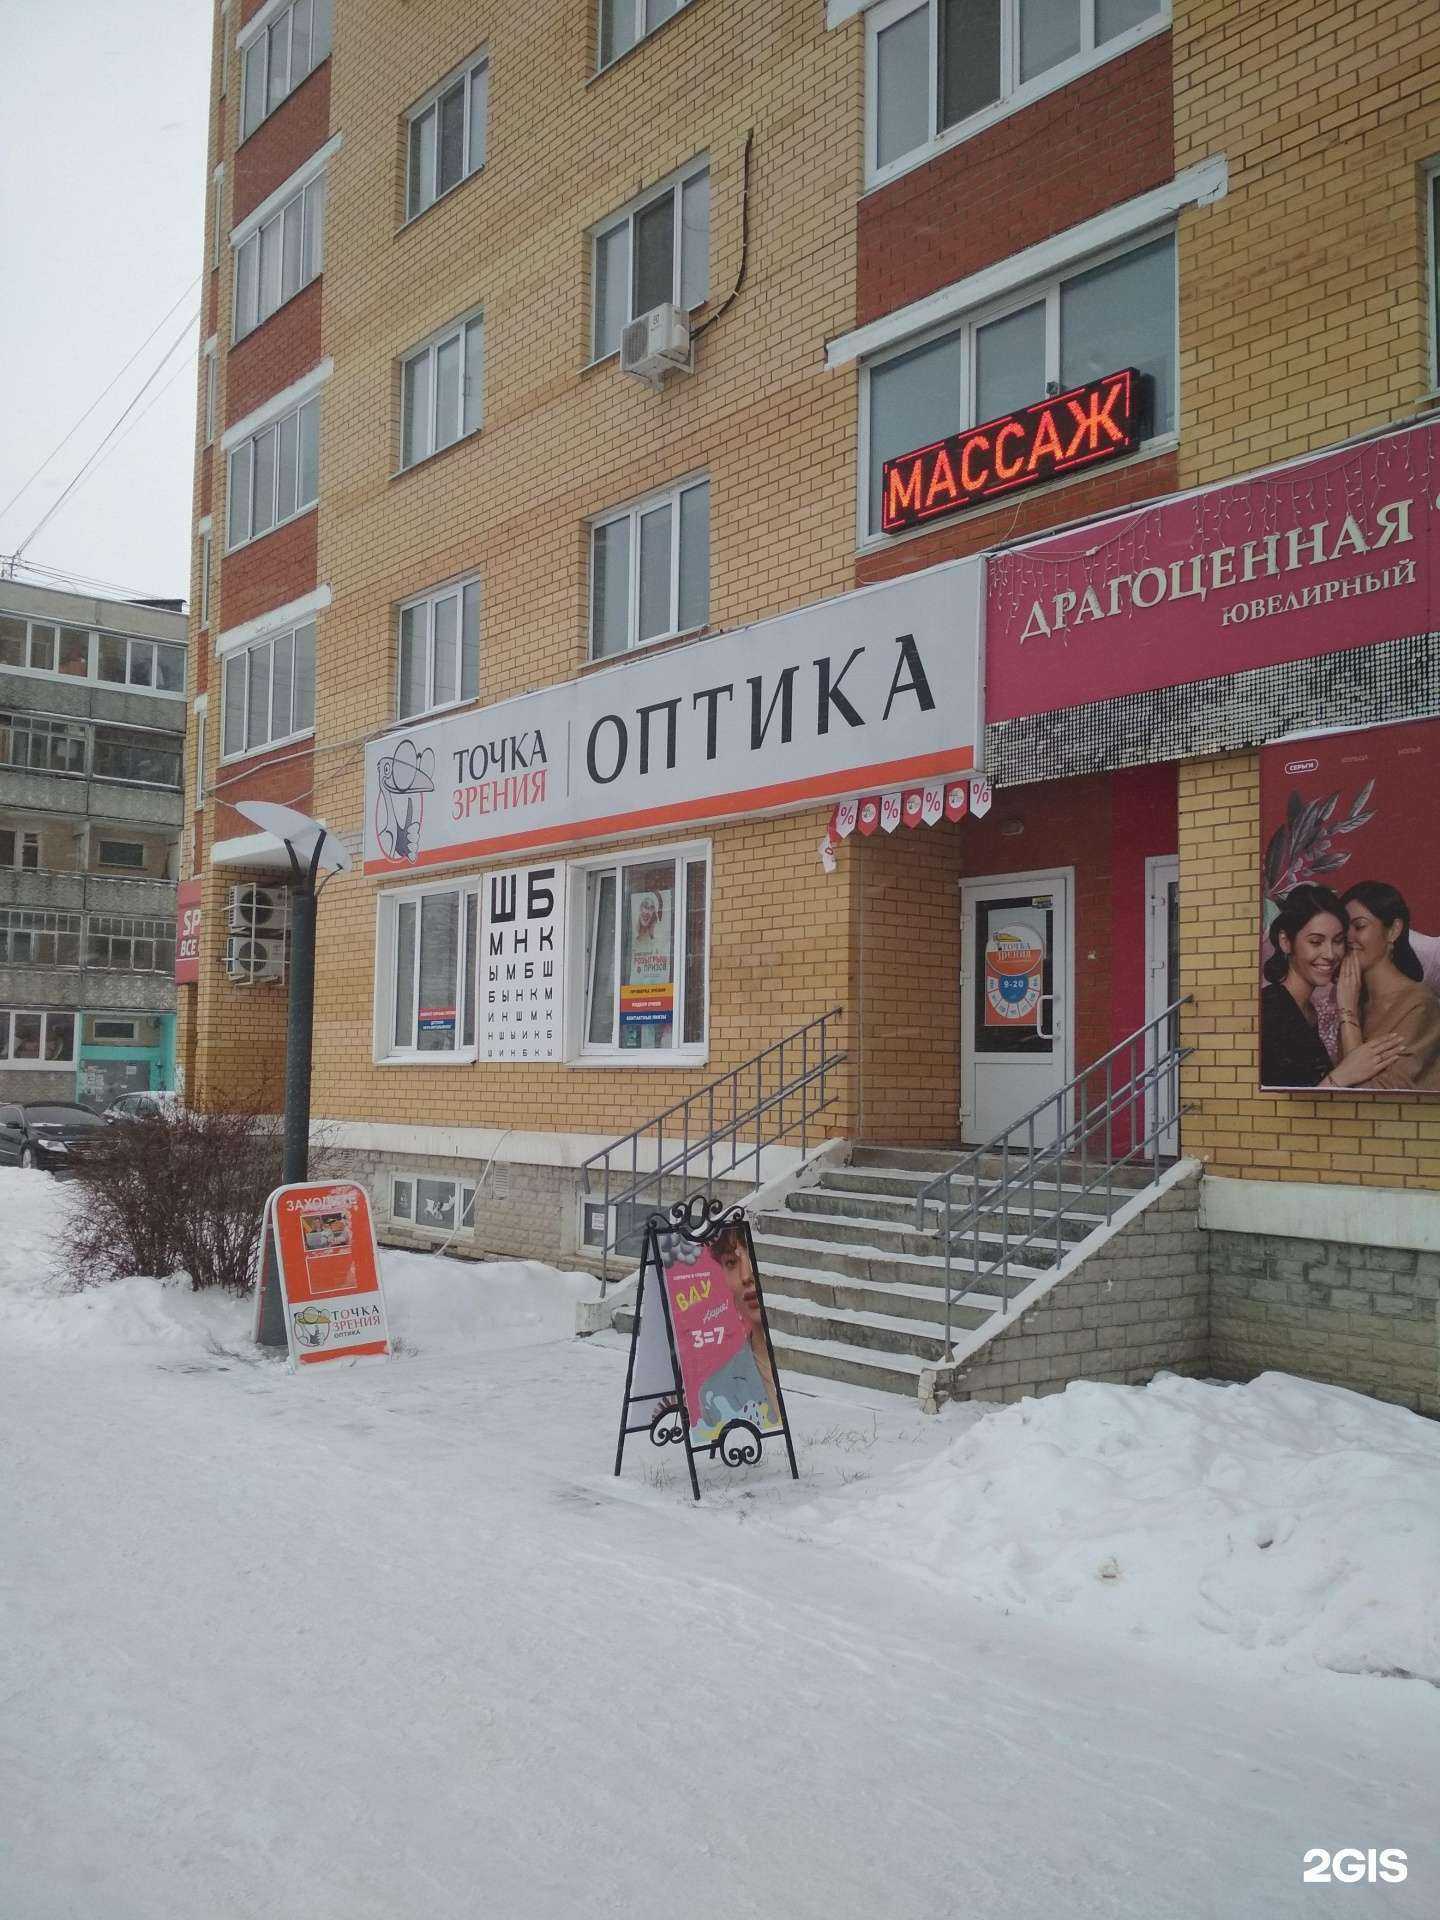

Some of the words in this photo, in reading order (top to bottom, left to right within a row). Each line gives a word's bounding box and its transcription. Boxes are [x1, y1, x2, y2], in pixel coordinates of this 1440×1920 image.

[888, 384, 1125, 518] МАССАЖ
[1019, 499, 1414, 644] ДРАГОЦЕННАЯ
[1221, 559, 1417, 627] ЮВЕЛИРНЫЙ
[587, 633, 936, 785] ОПТИКА
[452, 730, 548, 784] ТОЧКА
[452, 769, 548, 821] ЗРЕНИЯ
[331, 1305, 379, 1320] ТОЧКА
[332, 1316, 380, 1330] ЗРЕНИЯ
[691, 1326, 725, 1348] 3=7
